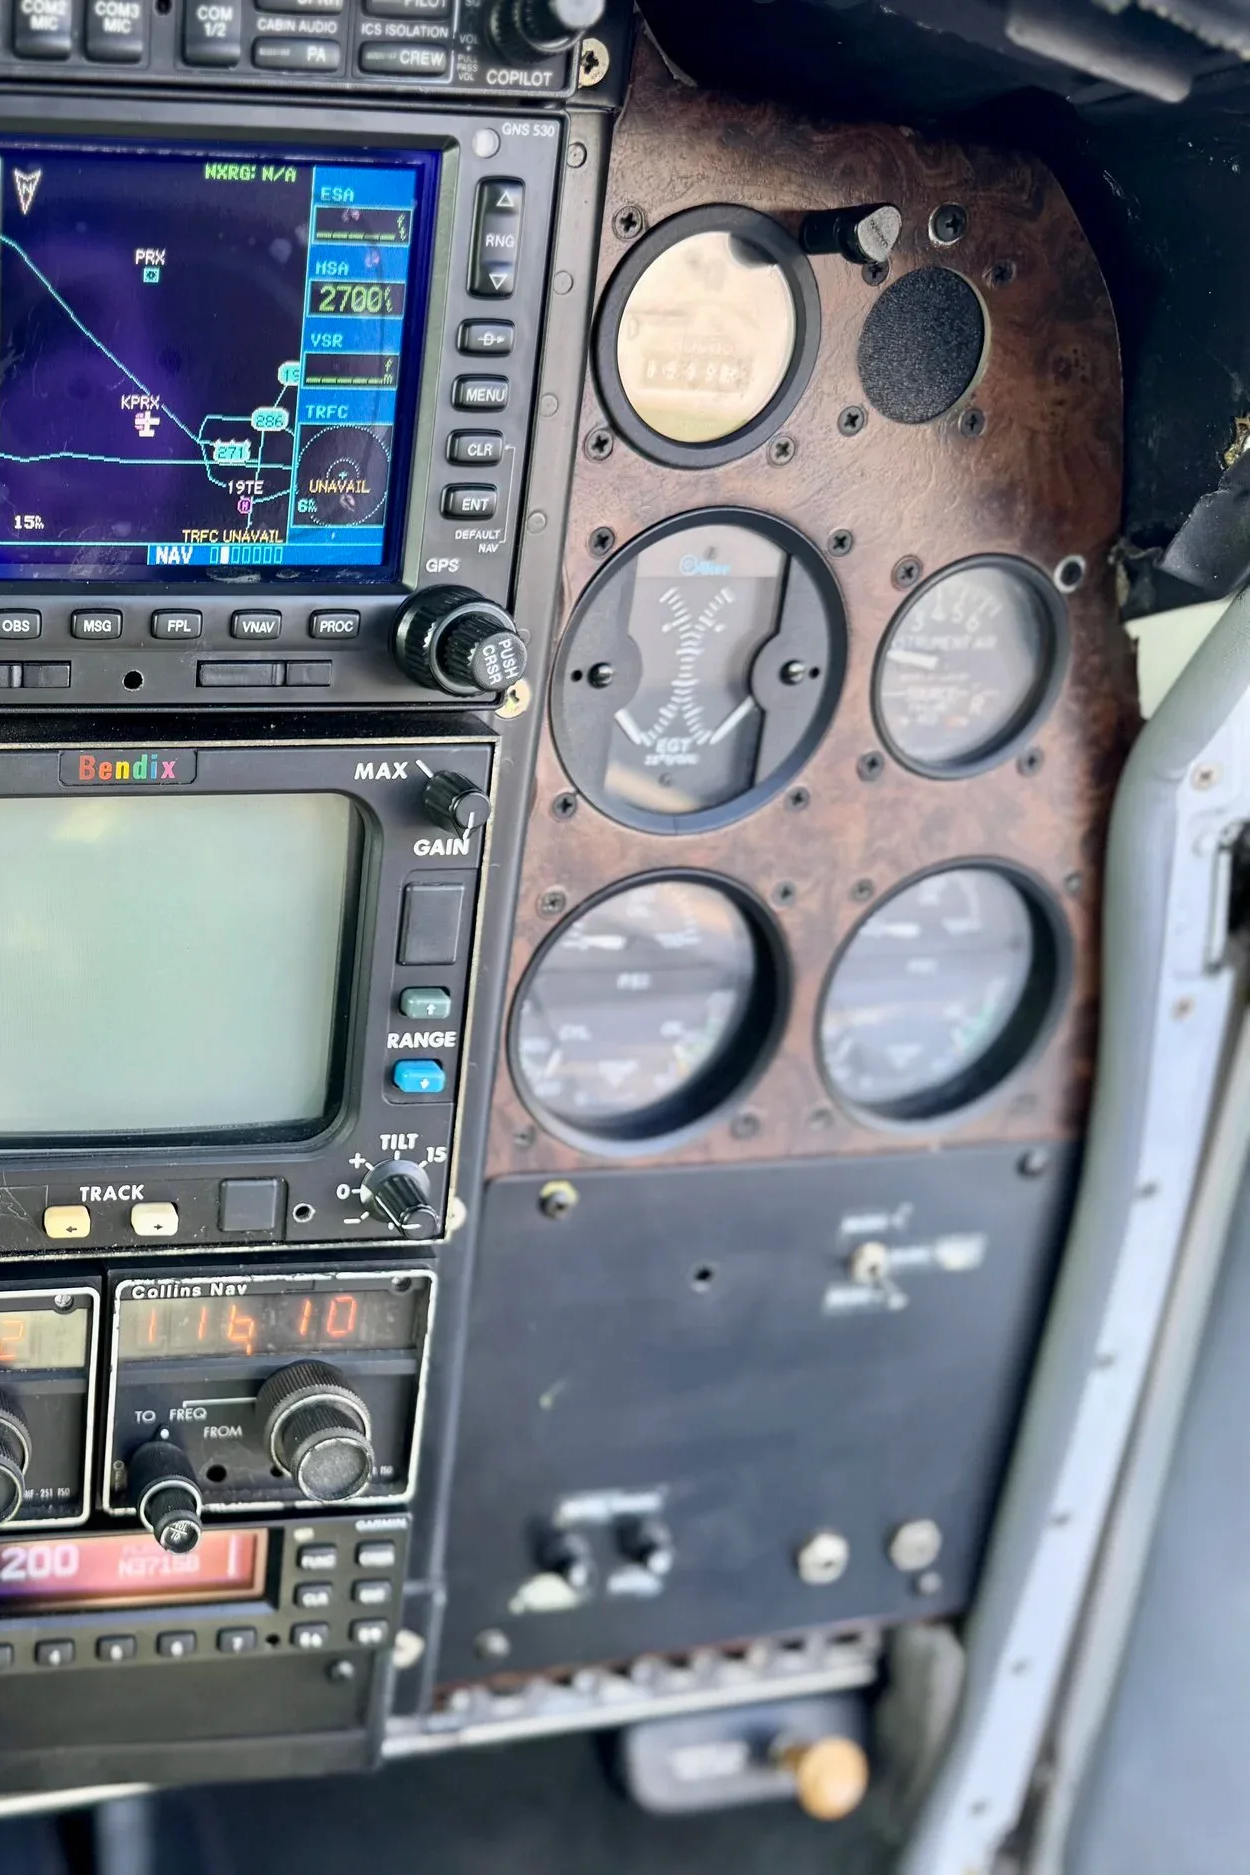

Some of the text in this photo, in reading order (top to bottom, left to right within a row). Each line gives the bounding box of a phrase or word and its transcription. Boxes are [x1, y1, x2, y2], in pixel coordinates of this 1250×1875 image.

[95, 1, 140, 18] COM3
[197, 6, 232, 22] COM
[30, 15, 59, 31] MIC
[104, 17, 131, 34] MIC
[204, 22, 226, 38] 1/2
[257, 19, 337, 35] CABIN AUDIO
[361, 23, 449, 39] ICS ISOLATION
[307, 45, 327, 63] PA
[399, 49, 444, 68] CREW
[486, 69, 553, 86] COPILOT
[501, 122, 555, 138] GNS 530
[261, 166, 297, 183] N/A
[320, 186, 355, 203] ESA
[485, 233, 515, 248] RNG
[135, 248, 166, 266] PRX
[310, 332, 344, 348] VSR
[121, 394, 161, 410] KPRX
[465, 387, 506, 402] MENU
[306, 404, 349, 419] TRFC
[255, 412, 284, 428] 286
[216, 445, 244, 460] 271
[467, 443, 493, 457] CLR
[226, 479, 265, 495] 19TE
[308, 479, 371, 495] UNAVAIL
[461, 498, 489, 512] ENT
[182, 529, 284, 544] TRFC UNAVAIL
[455, 529, 500, 541] DEFAULT
[155, 545, 194, 565] NAV
[478, 542, 500, 554] NAV
[425, 557, 461, 574] GPS
[1, 619, 31, 633] OBS
[83, 619, 112, 633] MSG
[167, 619, 192, 633] FPL
[242, 620, 275, 634] VNAV
[319, 620, 354, 634] PROC
[497, 637, 520, 680] PUSH
[655, 738, 693, 753] EGT
[78, 753, 177, 781] Bendix
[353, 761, 409, 780] MAX
[413, 838, 471, 857] GAIN
[386, 1031, 458, 1050] RANGE
[379, 1132, 419, 1151] TILT
[426, 1147, 448, 1163] 15
[79, 1184, 145, 1202] TRACK
[132, 1281, 248, 1300] Collins Nav
[135, 1406, 208, 1423] TO FREQ
[203, 1424, 243, 1438] FROM
[355, 1517, 408, 1532] GARMIN
